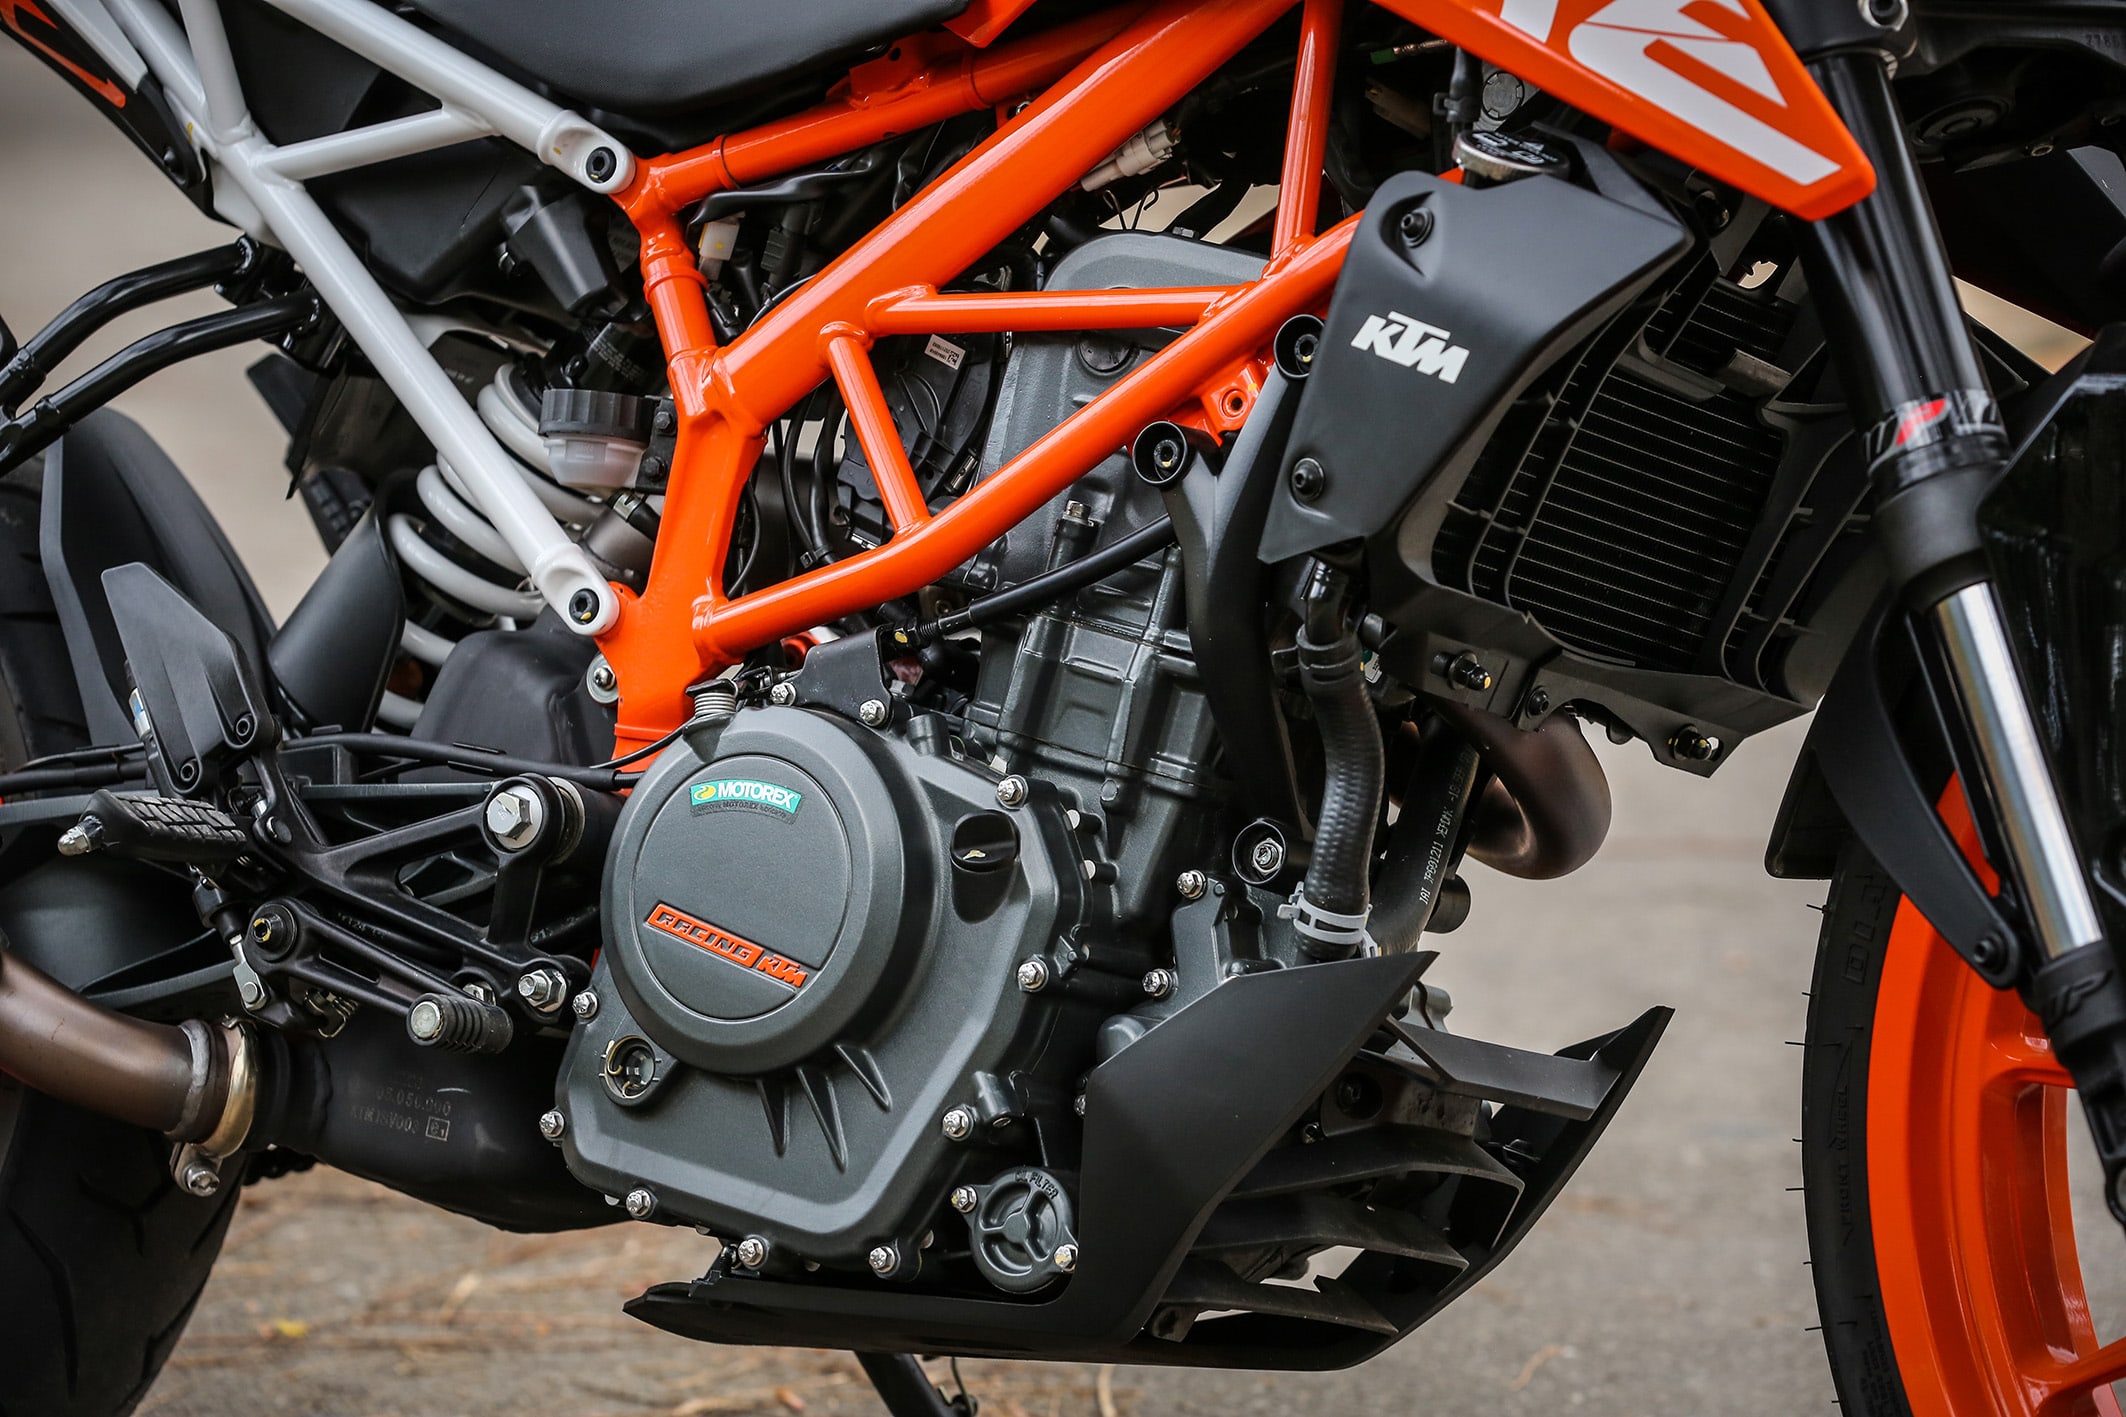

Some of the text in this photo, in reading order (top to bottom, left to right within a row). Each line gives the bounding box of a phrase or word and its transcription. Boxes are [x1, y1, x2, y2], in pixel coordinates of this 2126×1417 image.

[1350, 310, 1470, 384] KTM
[718, 782, 796, 809] MOTOREX
[655, 911, 809, 988] RACING KTM
[1029, 1172, 1058, 1199] FILTER
